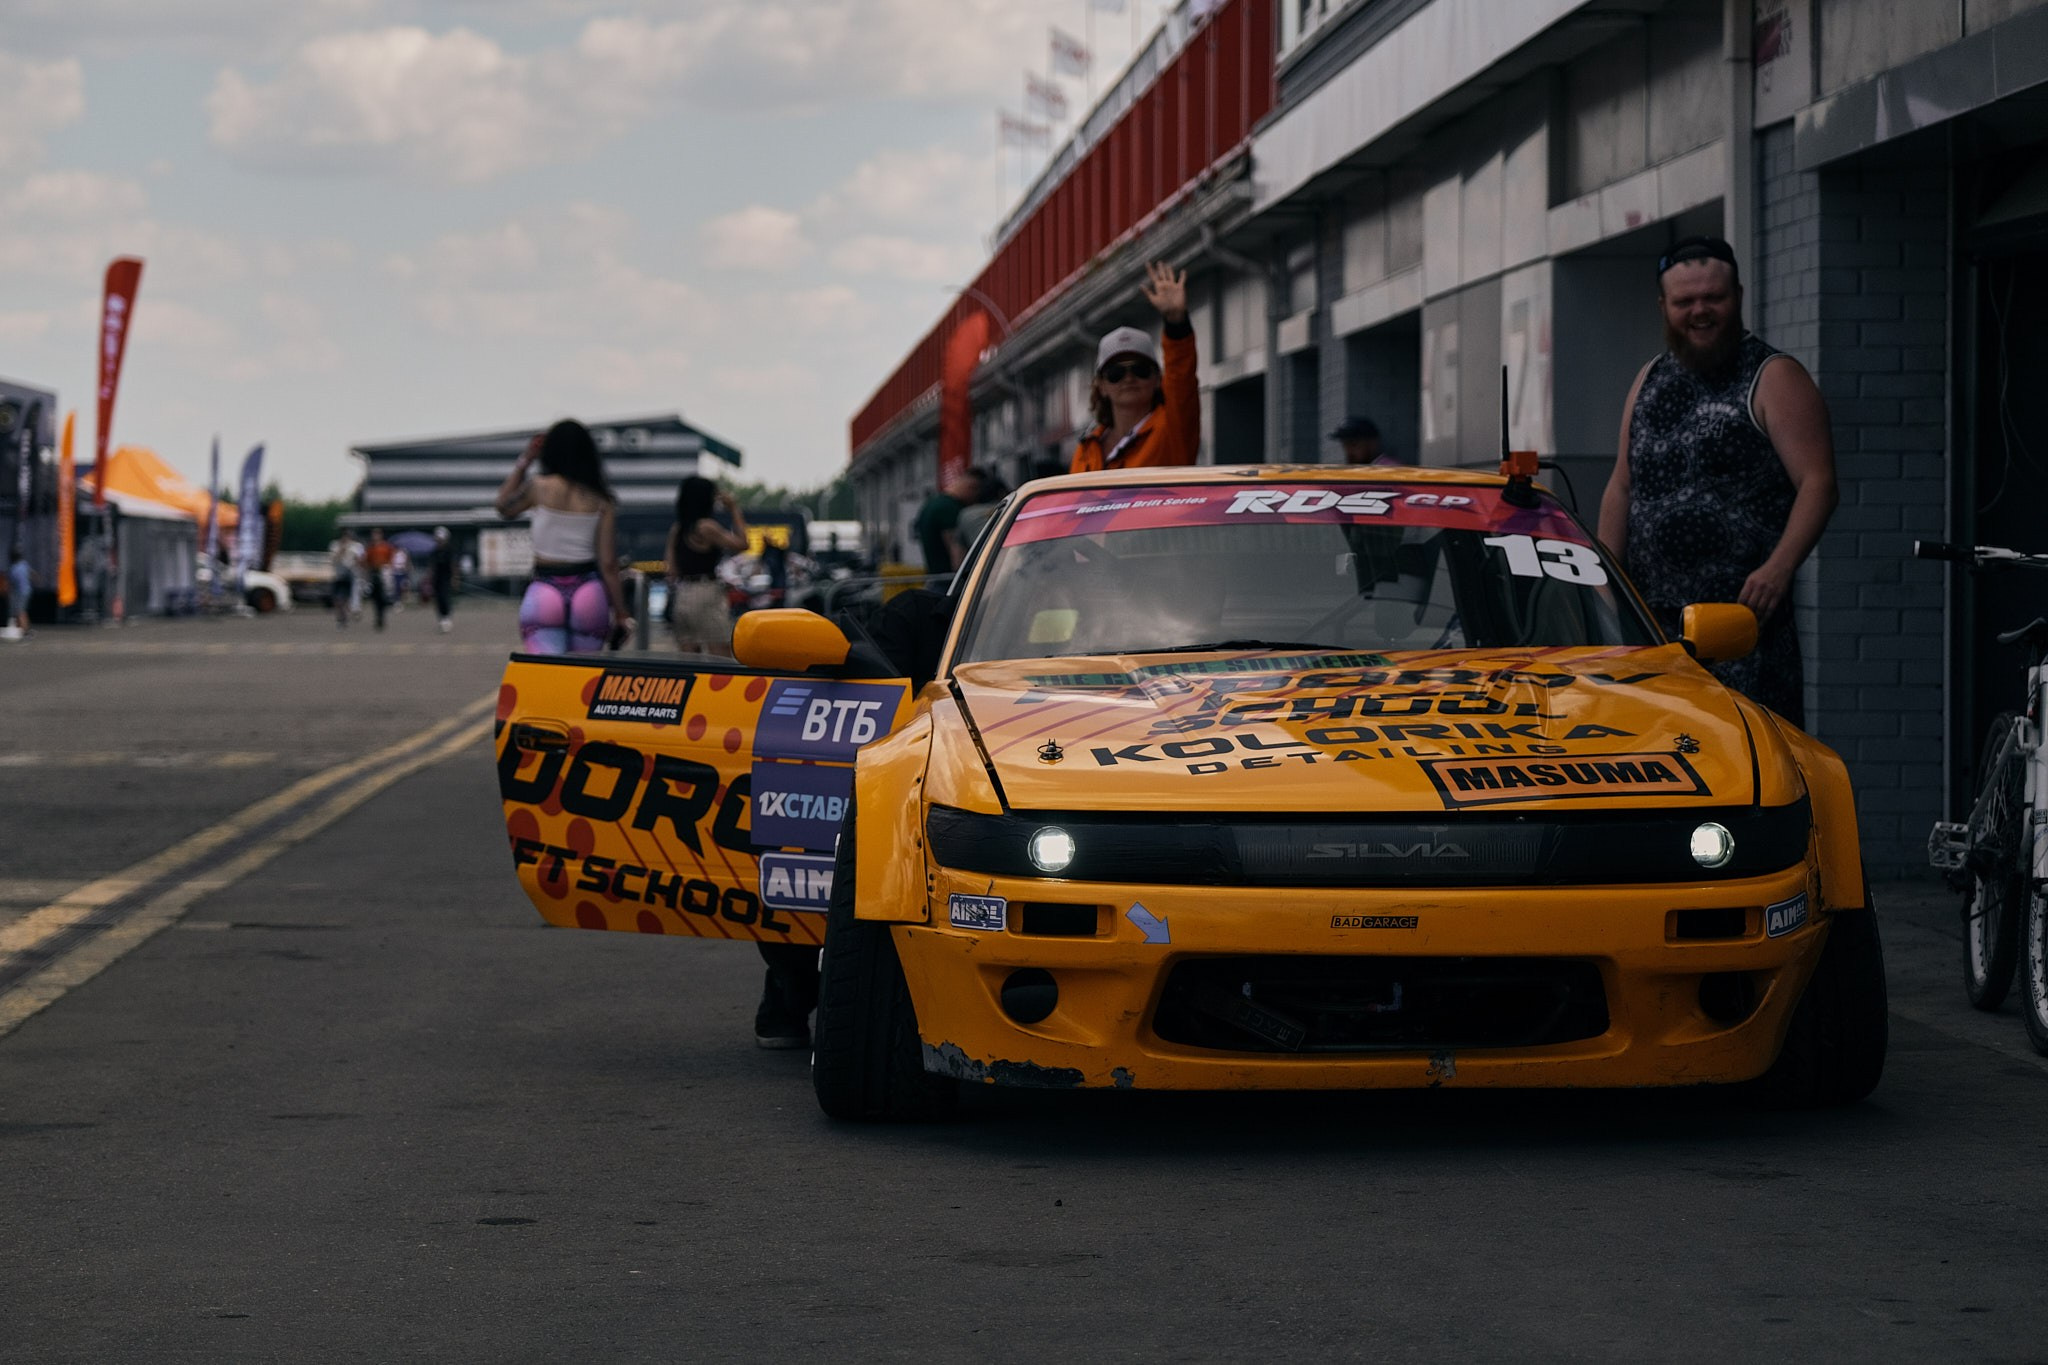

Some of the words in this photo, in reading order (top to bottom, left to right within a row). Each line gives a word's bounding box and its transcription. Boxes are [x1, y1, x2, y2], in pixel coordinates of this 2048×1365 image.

[1076, 501, 1131, 515] Russian
[1131, 498, 1164, 509] Drift
[1162, 496, 1208, 506] Series
[1224, 489, 1402, 515] RDS
[1403, 493, 1473, 508] GP
[1483, 534, 1608, 587] 13
[598, 674, 687, 705] MASUMA
[593, 703, 618, 716] AUTO
[617, 705, 649, 717] SPARE
[647, 707, 678, 720] PARTS
[801, 698, 883, 744] ВТБ
[1090, 722, 1641, 767] KOLORIKA
[1187, 744, 1569, 776] DETAILING
[1454, 759, 1677, 792] MASUMA
[1305, 842, 1471, 859] SILVIA
